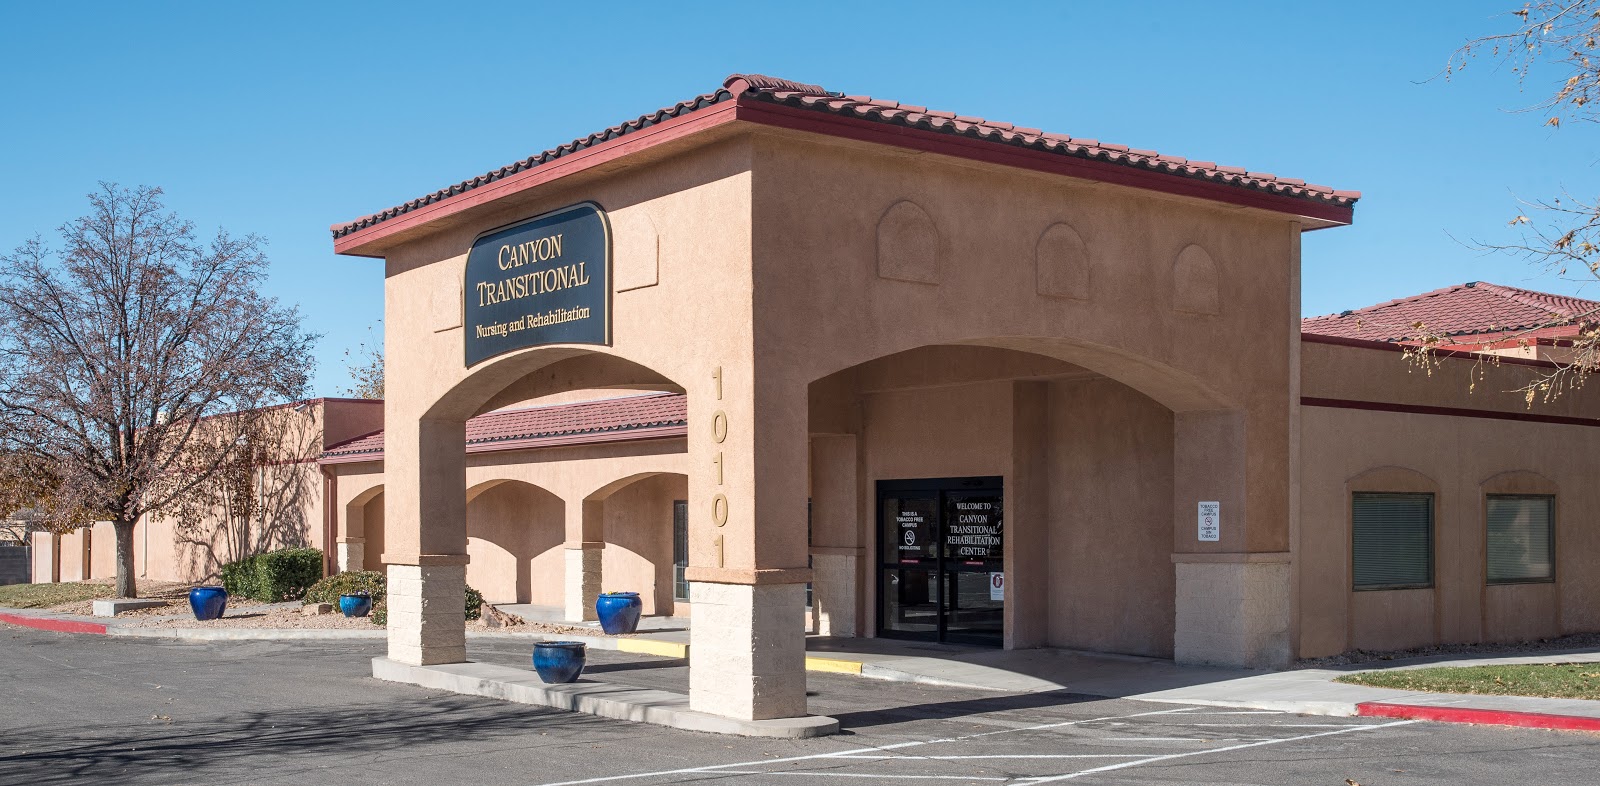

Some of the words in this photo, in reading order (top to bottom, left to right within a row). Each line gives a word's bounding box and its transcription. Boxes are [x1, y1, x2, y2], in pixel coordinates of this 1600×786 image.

[498, 233, 563, 271] CANYON
[476, 261, 590, 307] TRANSITIONAL
[475, 321, 508, 338] Nursing
[509, 316, 525, 333] and
[526, 305, 590, 329] Rehabilitation
[710, 365, 729, 569] 10101
[956, 502, 983, 510] WELCOME
[983, 502, 991, 510] TO
[959, 514, 988, 523] CANYON
[950, 525, 998, 534] TRANSITIONAL
[947, 536, 1000, 545] REHABILITATION
[960, 546, 986, 556] CENTER
